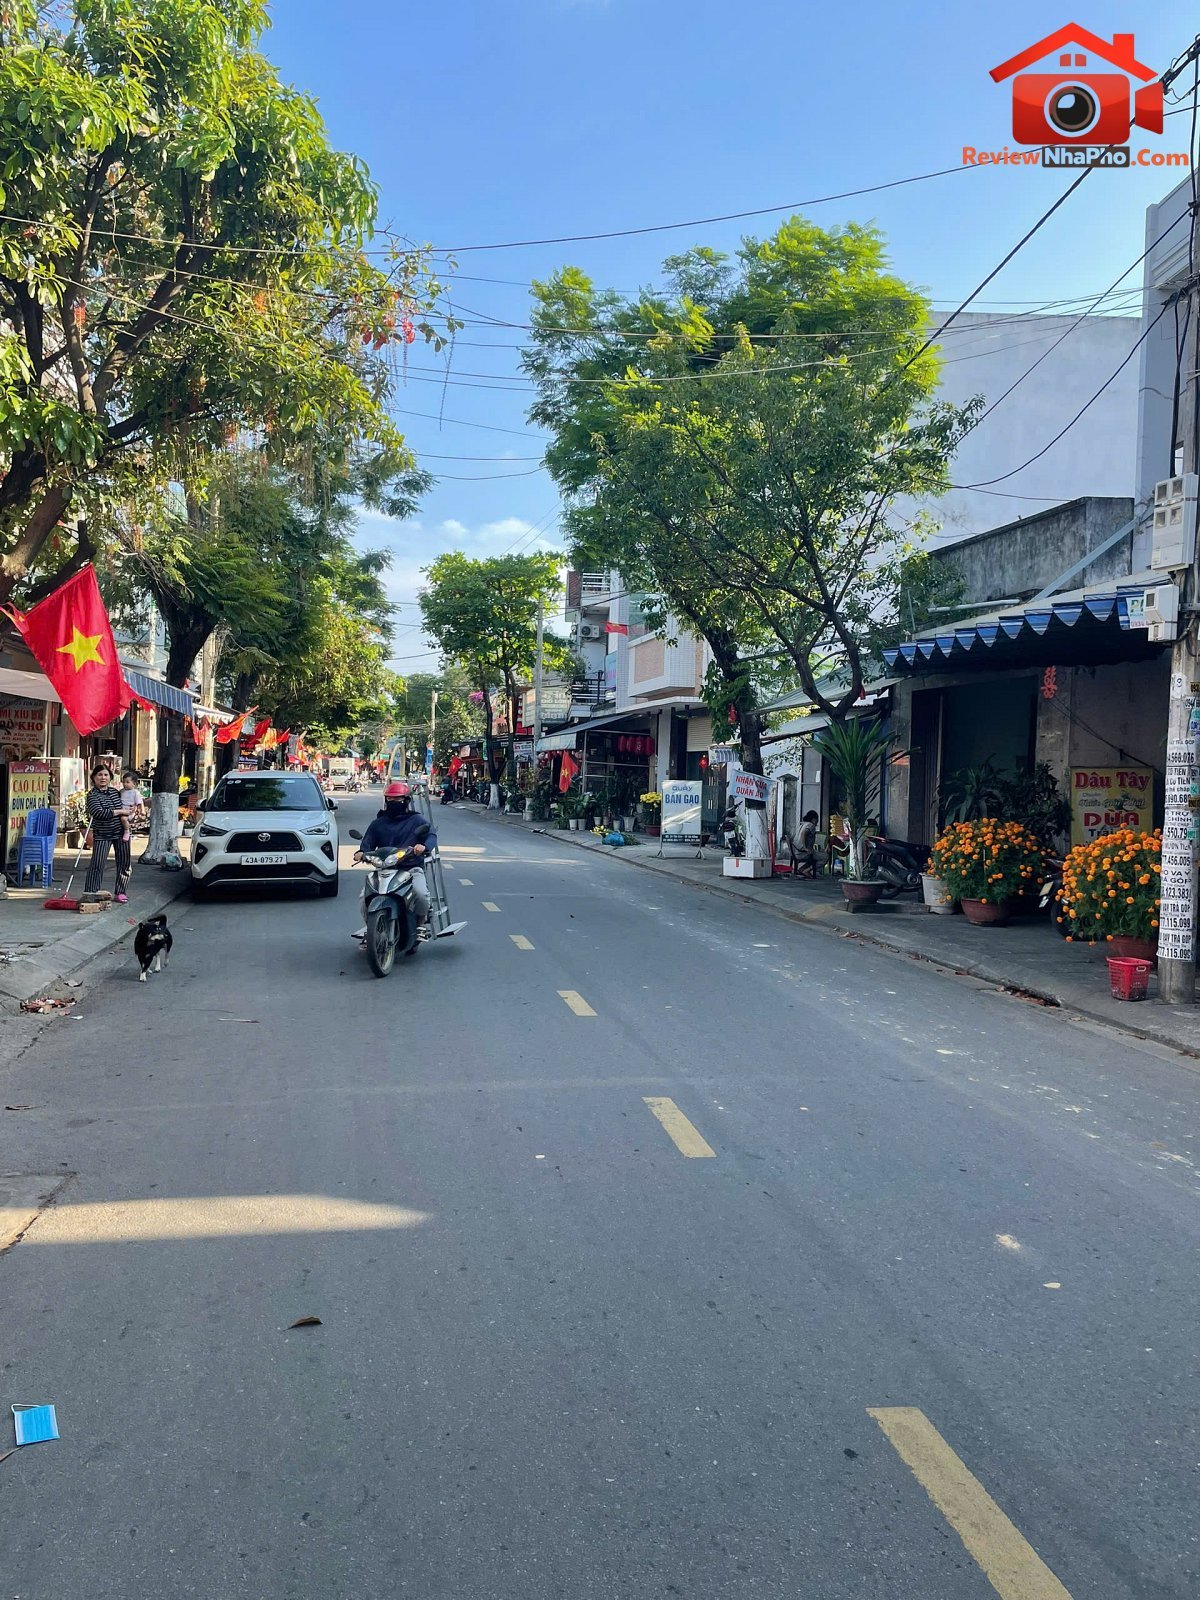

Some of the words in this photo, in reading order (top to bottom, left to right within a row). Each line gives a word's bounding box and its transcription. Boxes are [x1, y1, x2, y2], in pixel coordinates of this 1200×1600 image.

[18, 721, 43, 731] KHO
[24, 764, 35, 773] 29
[12, 780, 29, 793] CAO
[1074, 771, 1112, 789] Dâu
[1116, 771, 1150, 791] Tây
[12, 796, 25, 810] BÚN
[1084, 809, 1140, 827] DỪA
